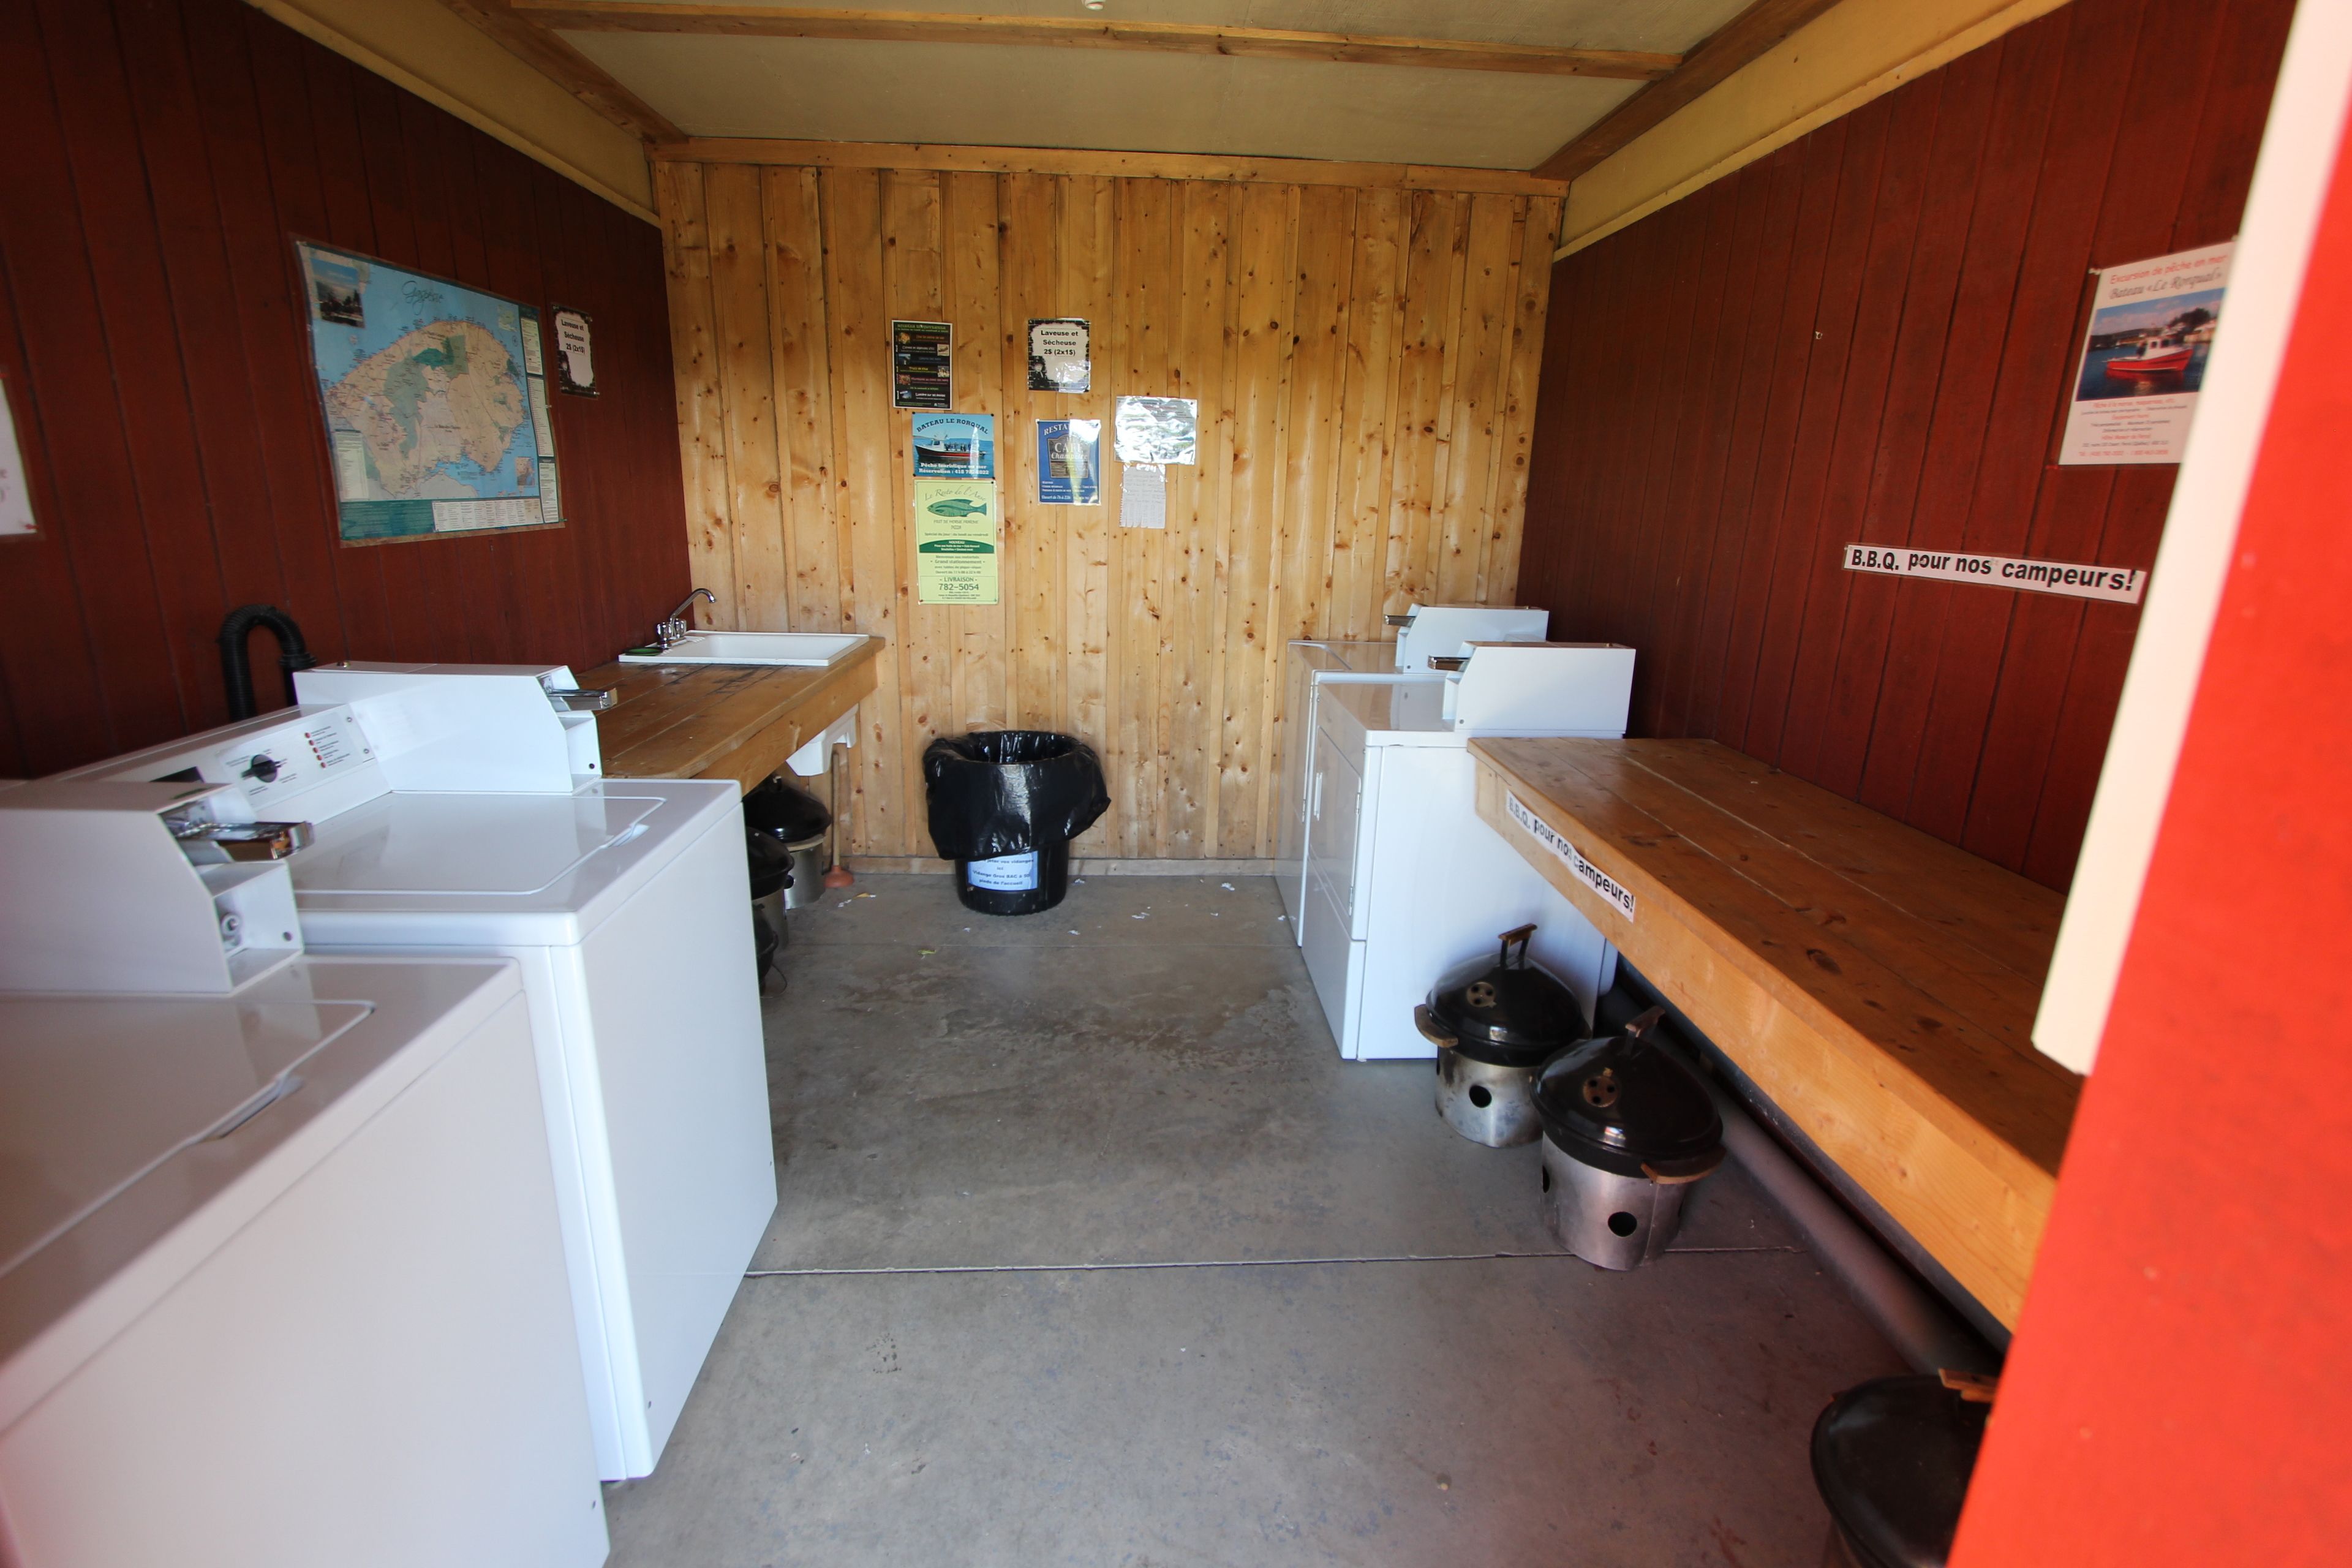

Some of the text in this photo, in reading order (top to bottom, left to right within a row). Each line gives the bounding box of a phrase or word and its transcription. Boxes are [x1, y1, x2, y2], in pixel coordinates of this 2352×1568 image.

[2152, 266, 2162, 275] de
[2109, 286, 2144, 300] Bateau
[561, 319, 579, 330] Laveuse
[916, 418, 944, 432] BATEAU
[957, 418, 989, 434] RORQUAL
[935, 488, 954, 497] Resto
[1851, 549, 2138, 592] B.B.Q. pour nos campeurs!
[1509, 796, 1635, 913] B.B.Q. pour nos campeurs!
